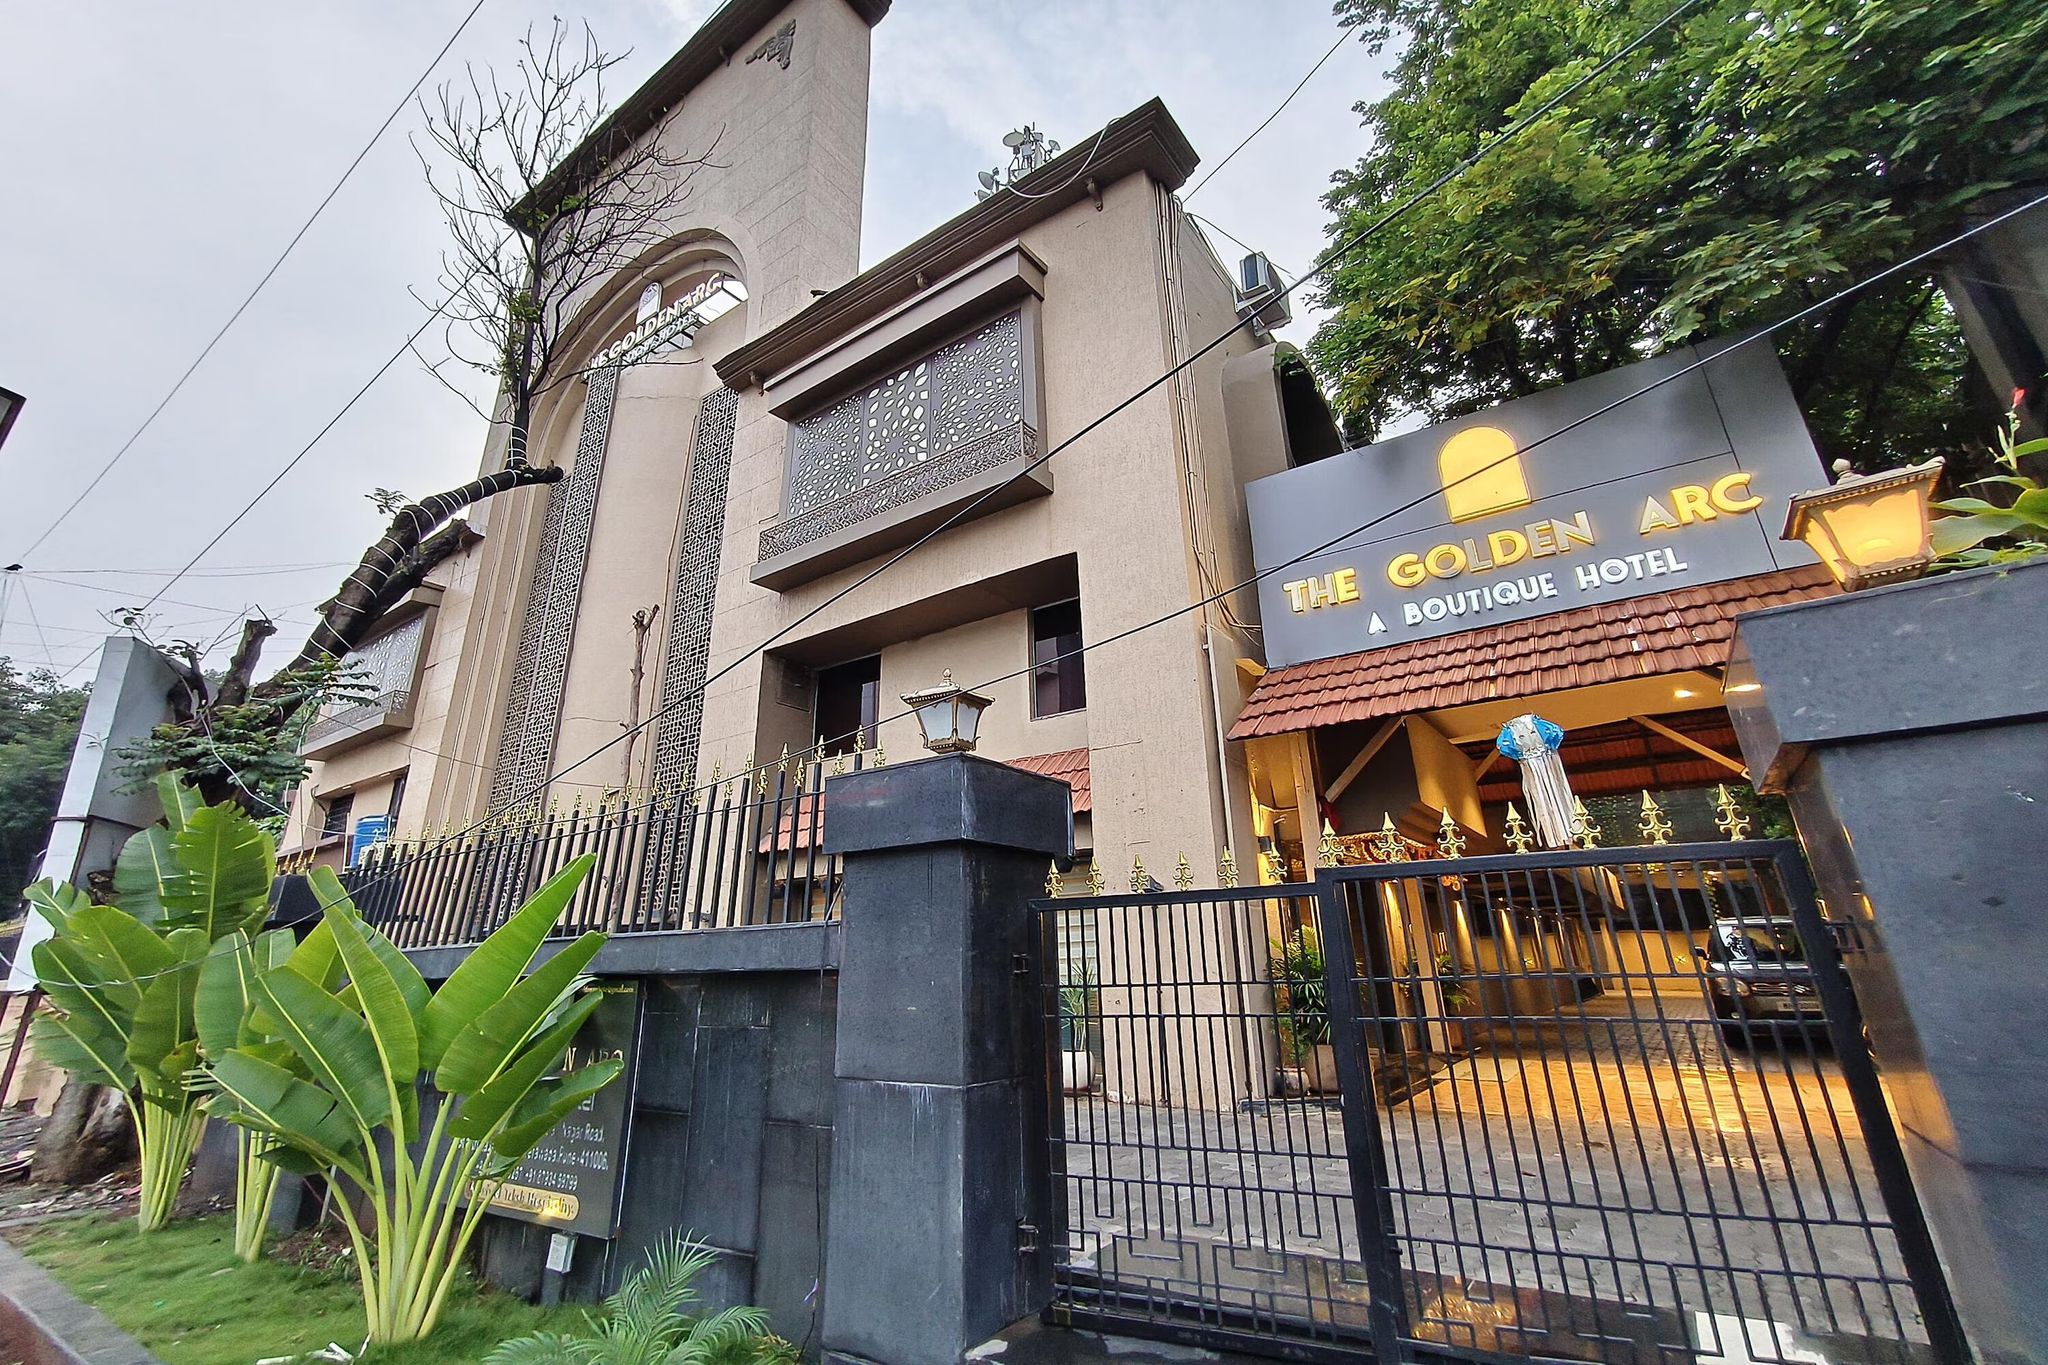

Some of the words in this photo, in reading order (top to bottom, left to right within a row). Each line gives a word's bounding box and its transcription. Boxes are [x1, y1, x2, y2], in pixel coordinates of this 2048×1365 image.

[608, 300, 681, 360] GOLDEN
[1282, 567, 1360, 614] THE
[1387, 510, 1595, 588] GOLDEN
[1638, 472, 1765, 536] ARC
[1366, 611, 1387, 635] A
[1403, 572, 1557, 627] BOUTIQUE
[1576, 546, 1688, 590] HOTEL
